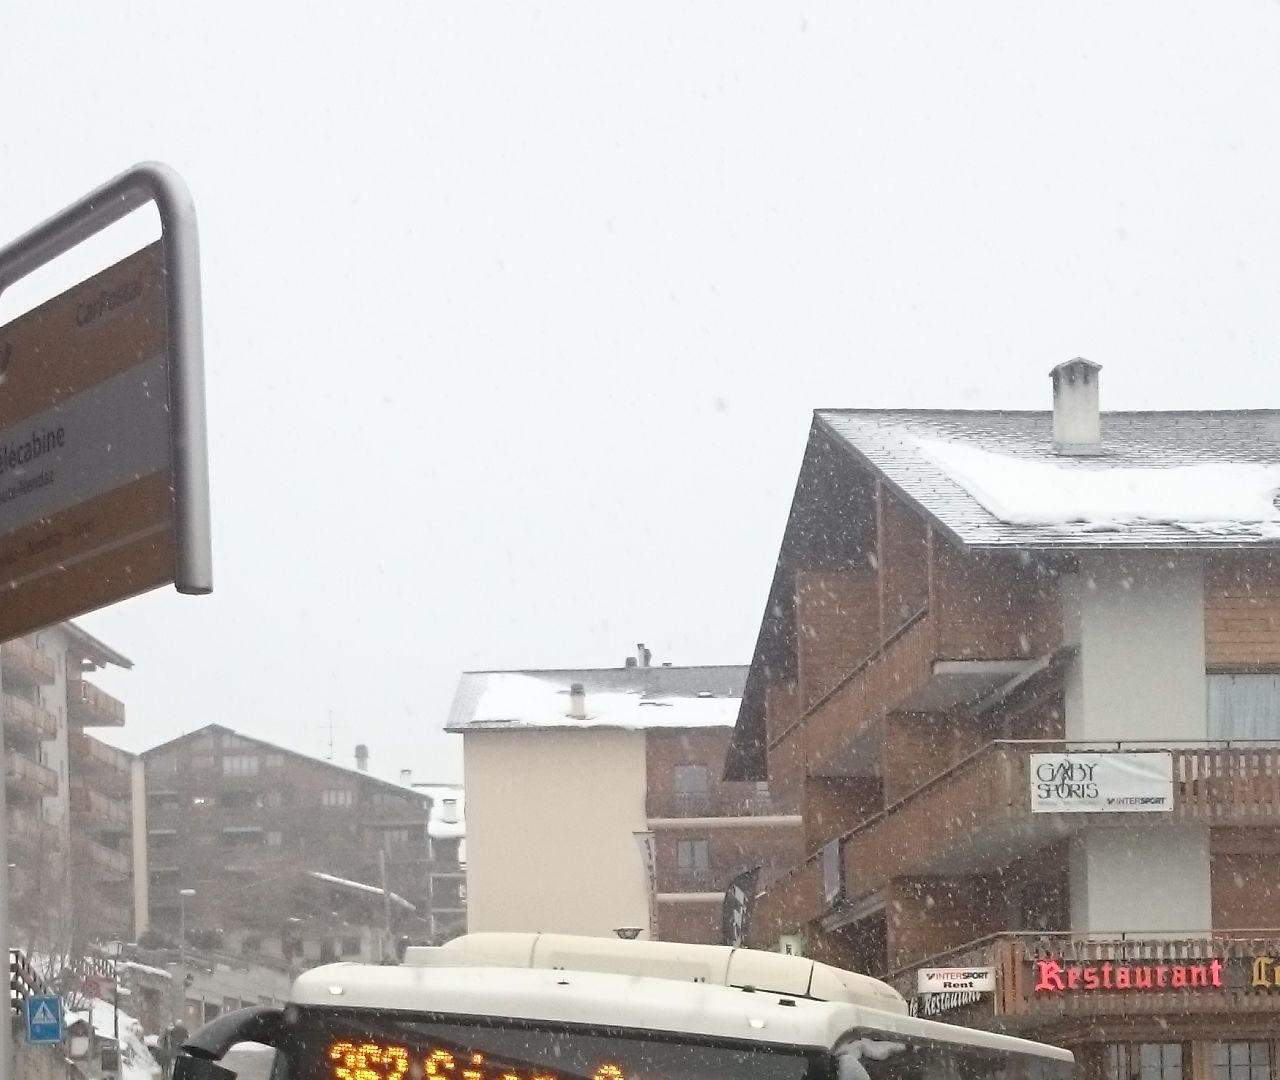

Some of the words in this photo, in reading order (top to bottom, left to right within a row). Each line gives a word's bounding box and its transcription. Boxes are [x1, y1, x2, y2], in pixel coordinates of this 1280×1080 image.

[1115, 797, 1166, 805] INTERSPORT
[936, 971, 989, 981] INTERSPORT
[1034, 959, 1222, 992] Restaurant
[943, 981, 975, 989] Rent
